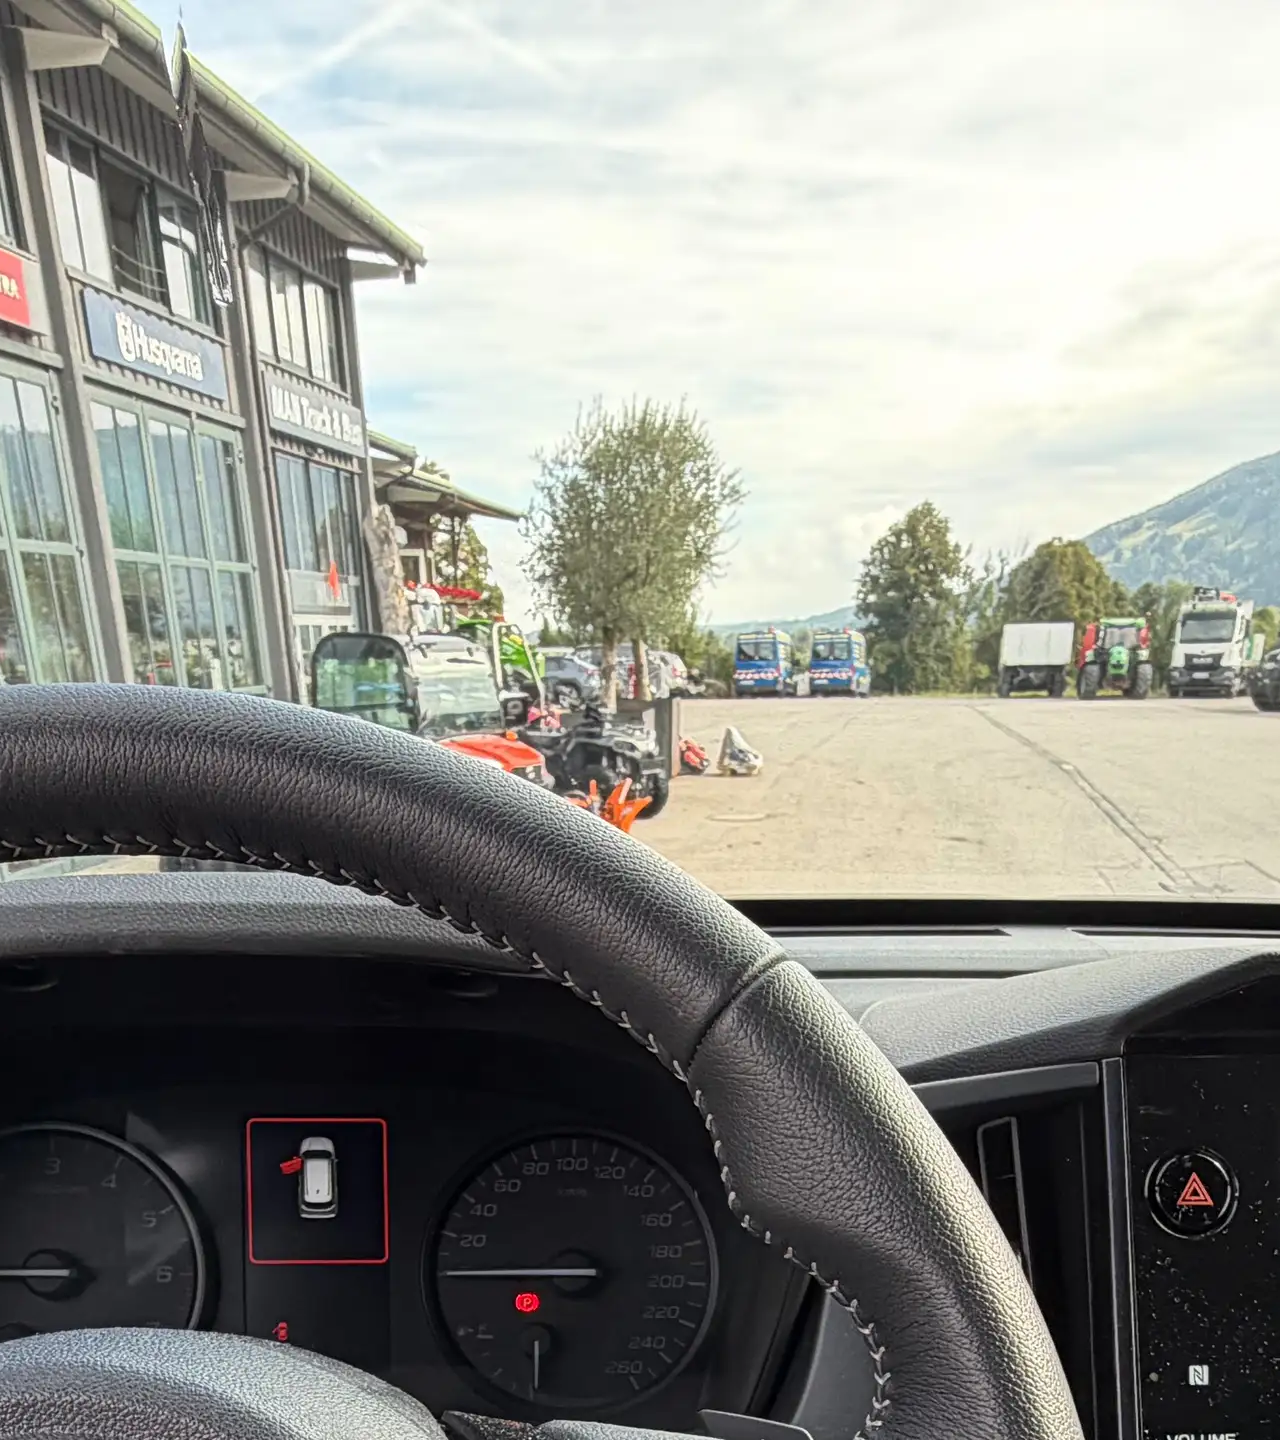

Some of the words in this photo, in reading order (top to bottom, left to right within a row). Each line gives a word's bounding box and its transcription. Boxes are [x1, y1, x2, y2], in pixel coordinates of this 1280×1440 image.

[45, 1158, 61, 1175] 3
[522, 1162, 550, 1176] 80
[556, 1157, 589, 1171] 100
[101, 1174, 117, 1188] 4
[493, 1179, 521, 1193] 60
[624, 1184, 655, 1198] 140
[470, 1204, 497, 1218] 40
[141, 1212, 157, 1228] 5
[641, 1214, 672, 1227] 160
[460, 1234, 487, 1247] 20
[651, 1245, 682, 1258] 180
[156, 1266, 173, 1282] 6
[647, 1275, 685, 1288] 200
[643, 1305, 680, 1319] 220
[628, 1336, 665, 1349] 240
[605, 1360, 642, 1374] 260
